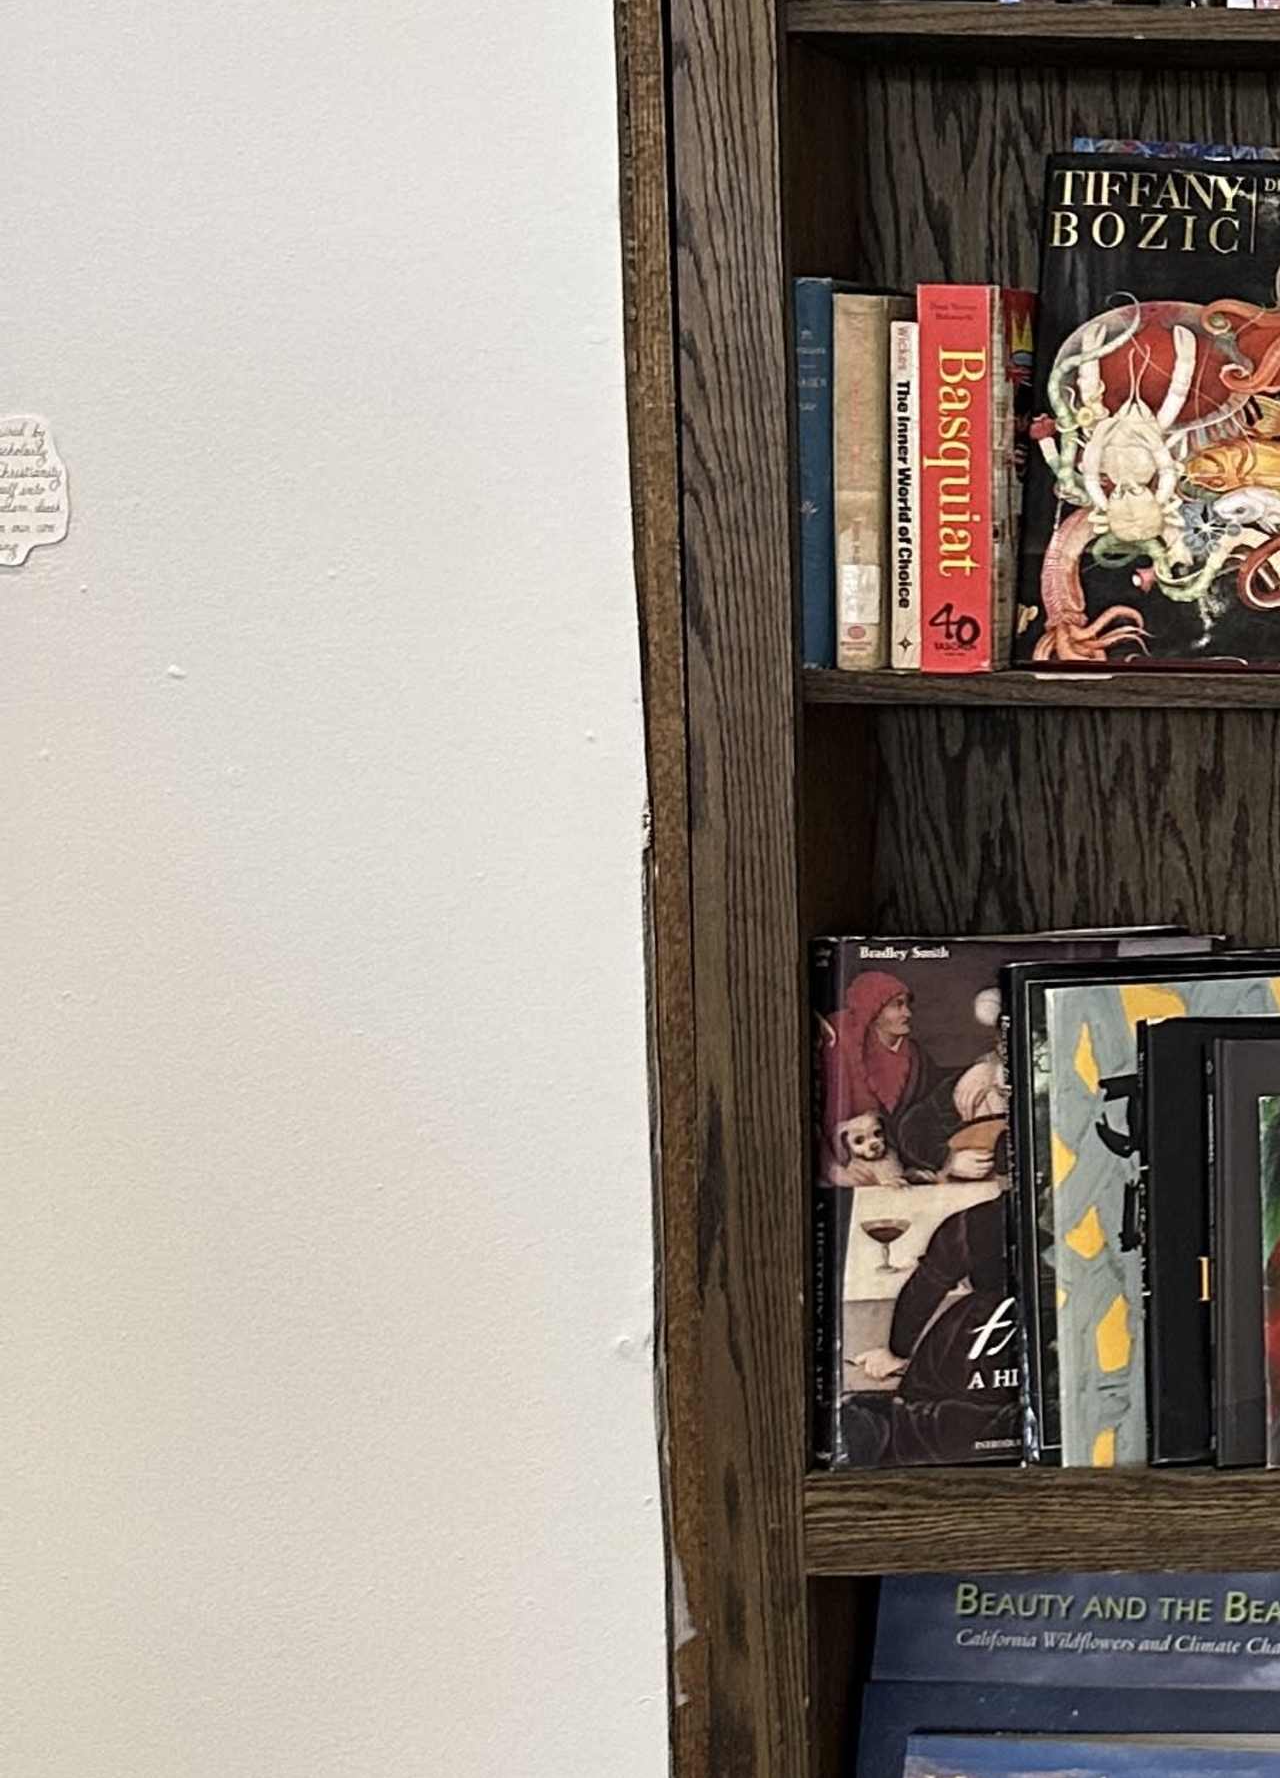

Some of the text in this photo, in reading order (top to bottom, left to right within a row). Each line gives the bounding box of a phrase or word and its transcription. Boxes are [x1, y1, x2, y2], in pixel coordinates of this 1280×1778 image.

[1054, 171, 1246, 212] TIFFANY
[1050, 211, 1241, 254] BOZIC
[923, 347, 987, 578] Basquiat
[896, 379, 912, 610] The Inner World of Choice
[929, 602, 982, 648] 40
[859, 946, 950, 961] Bradley Smith
[968, 1370, 1021, 1390] A HI
[955, 1583, 1074, 1619] BEAUTY
[1082, 1594, 1147, 1621] AND
[1157, 1598, 1212, 1623] THE
[956, 1629, 1037, 1651] California
[1043, 1631, 1136, 1652] Wildflowers
[1138, 1636, 1171, 1651] and
[1174, 1636, 1242, 1654] Climate
